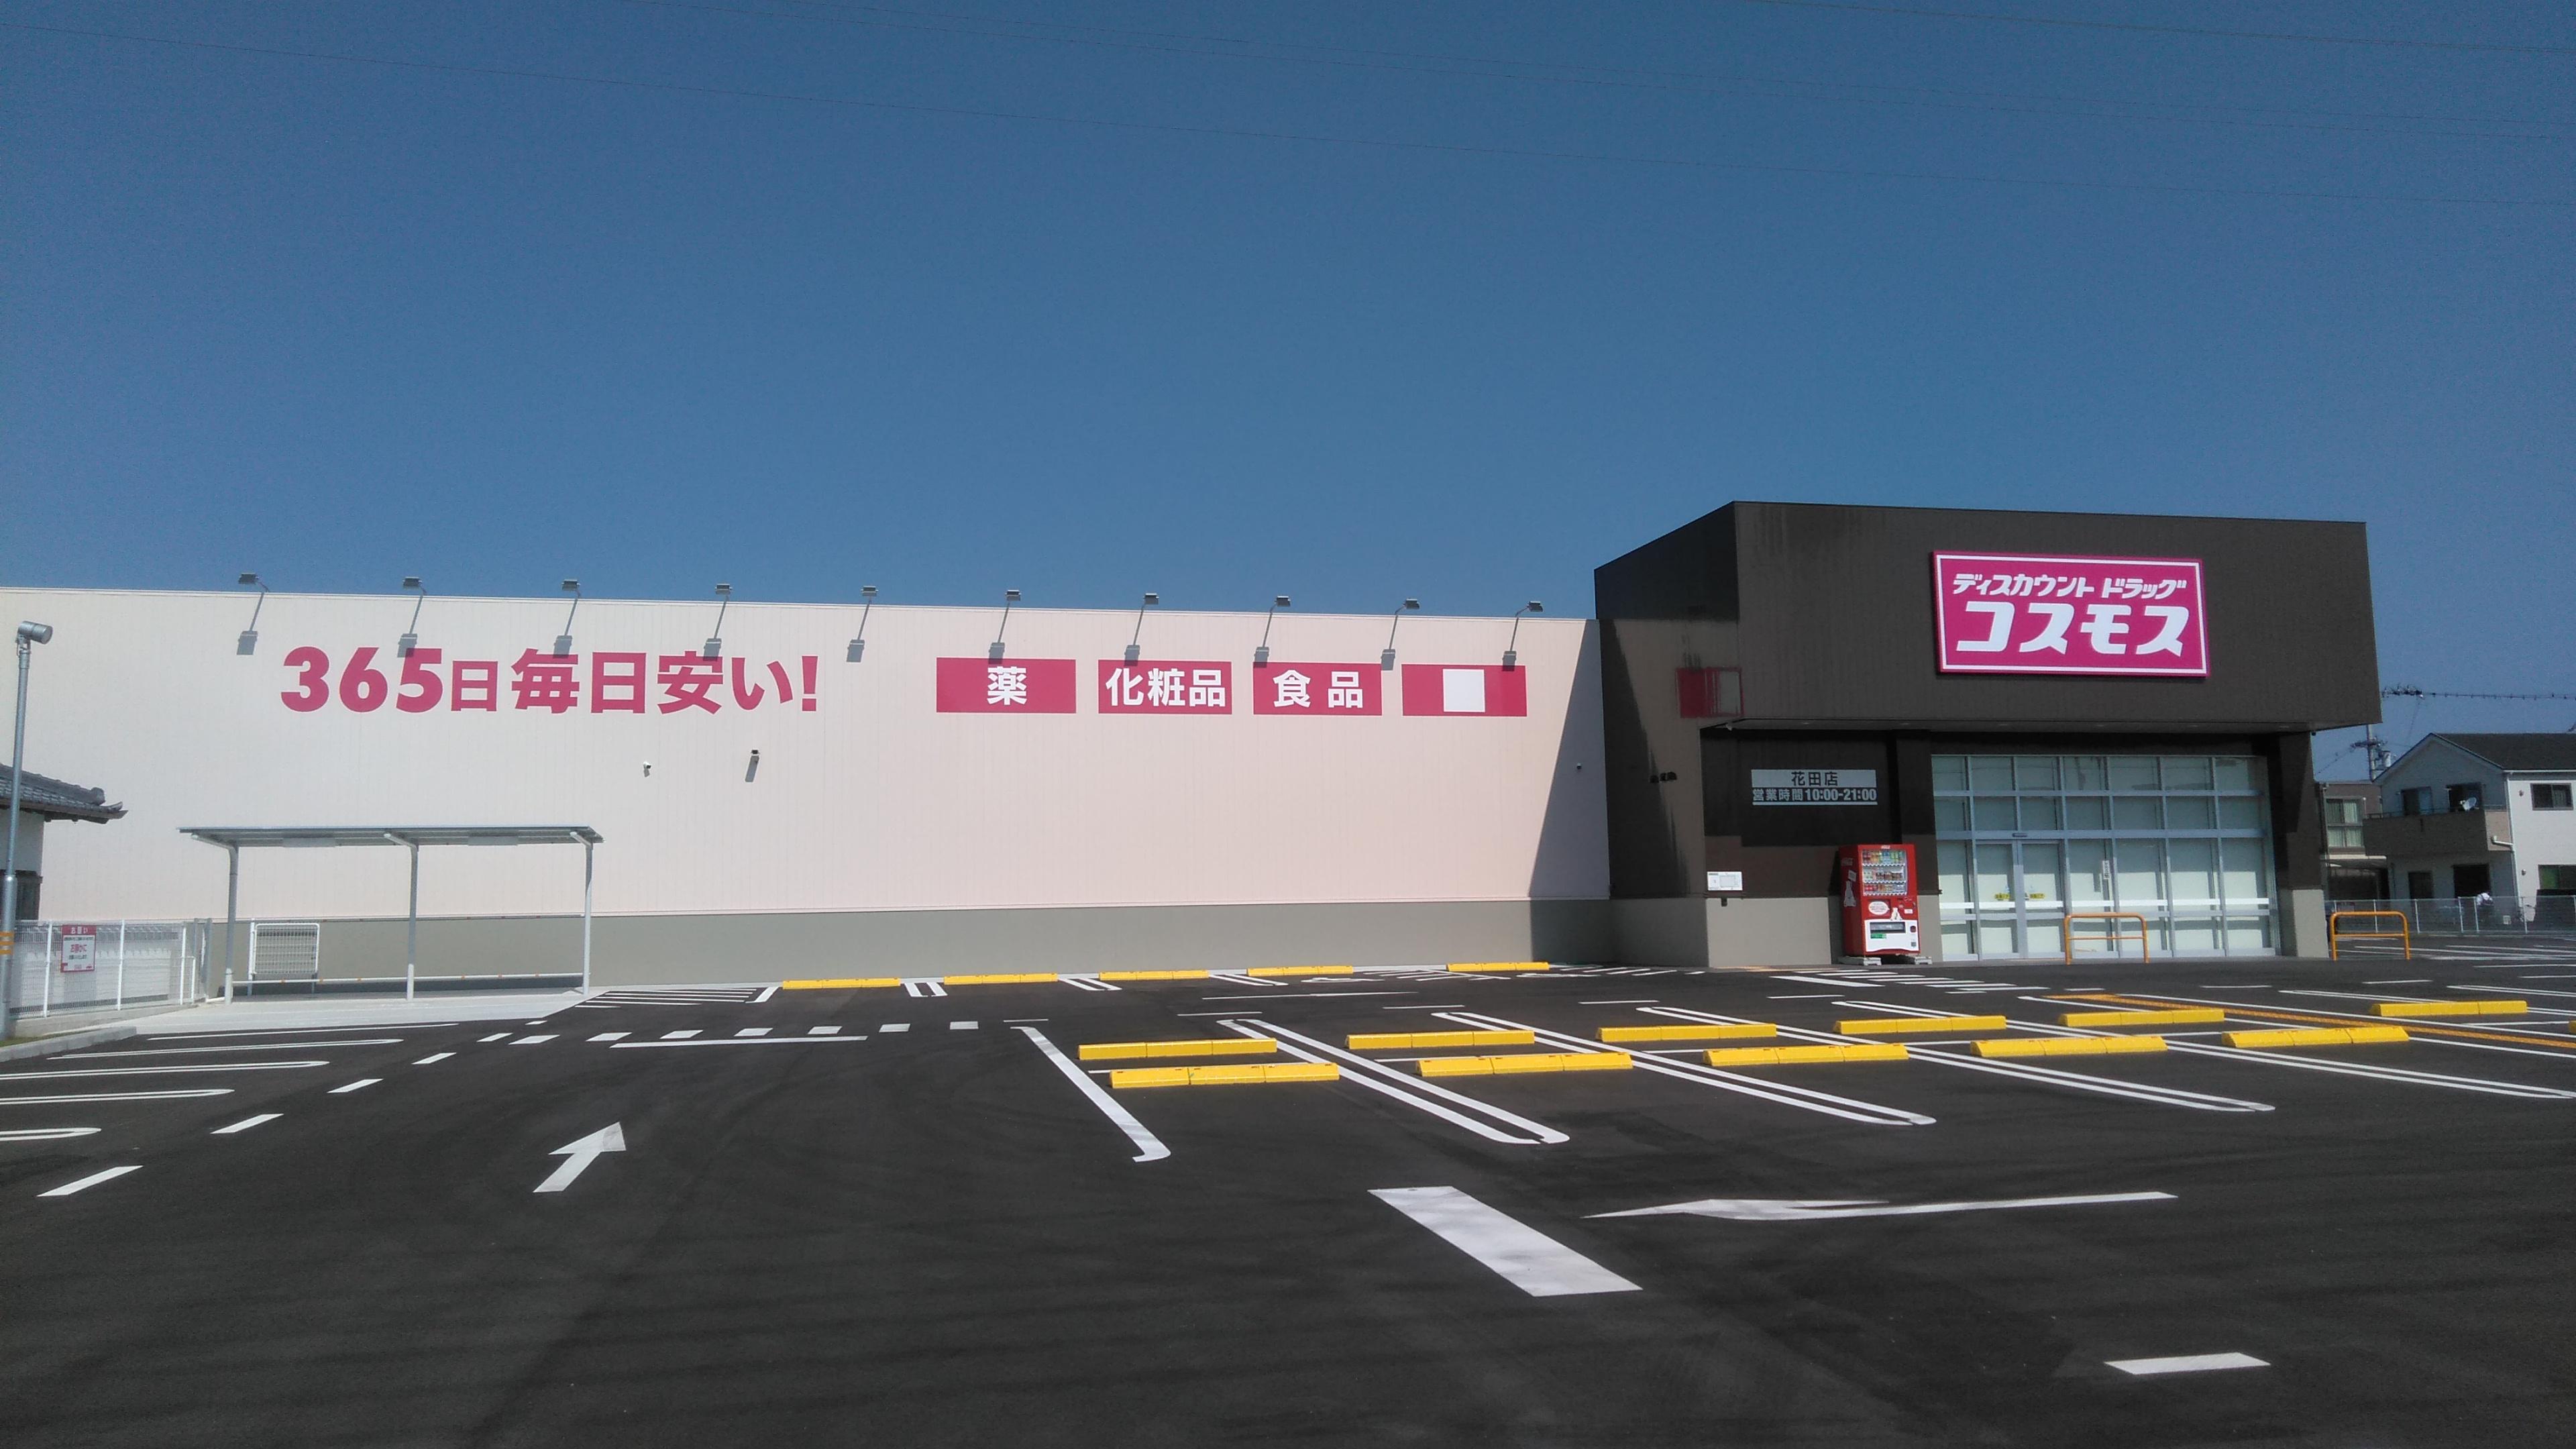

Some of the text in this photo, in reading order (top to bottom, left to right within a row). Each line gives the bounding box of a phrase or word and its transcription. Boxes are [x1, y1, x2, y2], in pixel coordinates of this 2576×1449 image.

[1953, 574, 2187, 600] ディスカウント ドラッグ
[1956, 600, 2190, 657] コスモス
[987, 666, 1028, 706] 薬
[1105, 667, 1226, 707] 化粧品
[1273, 669, 1364, 708] 食品
[1791, 771, 1838, 786] 花田店
